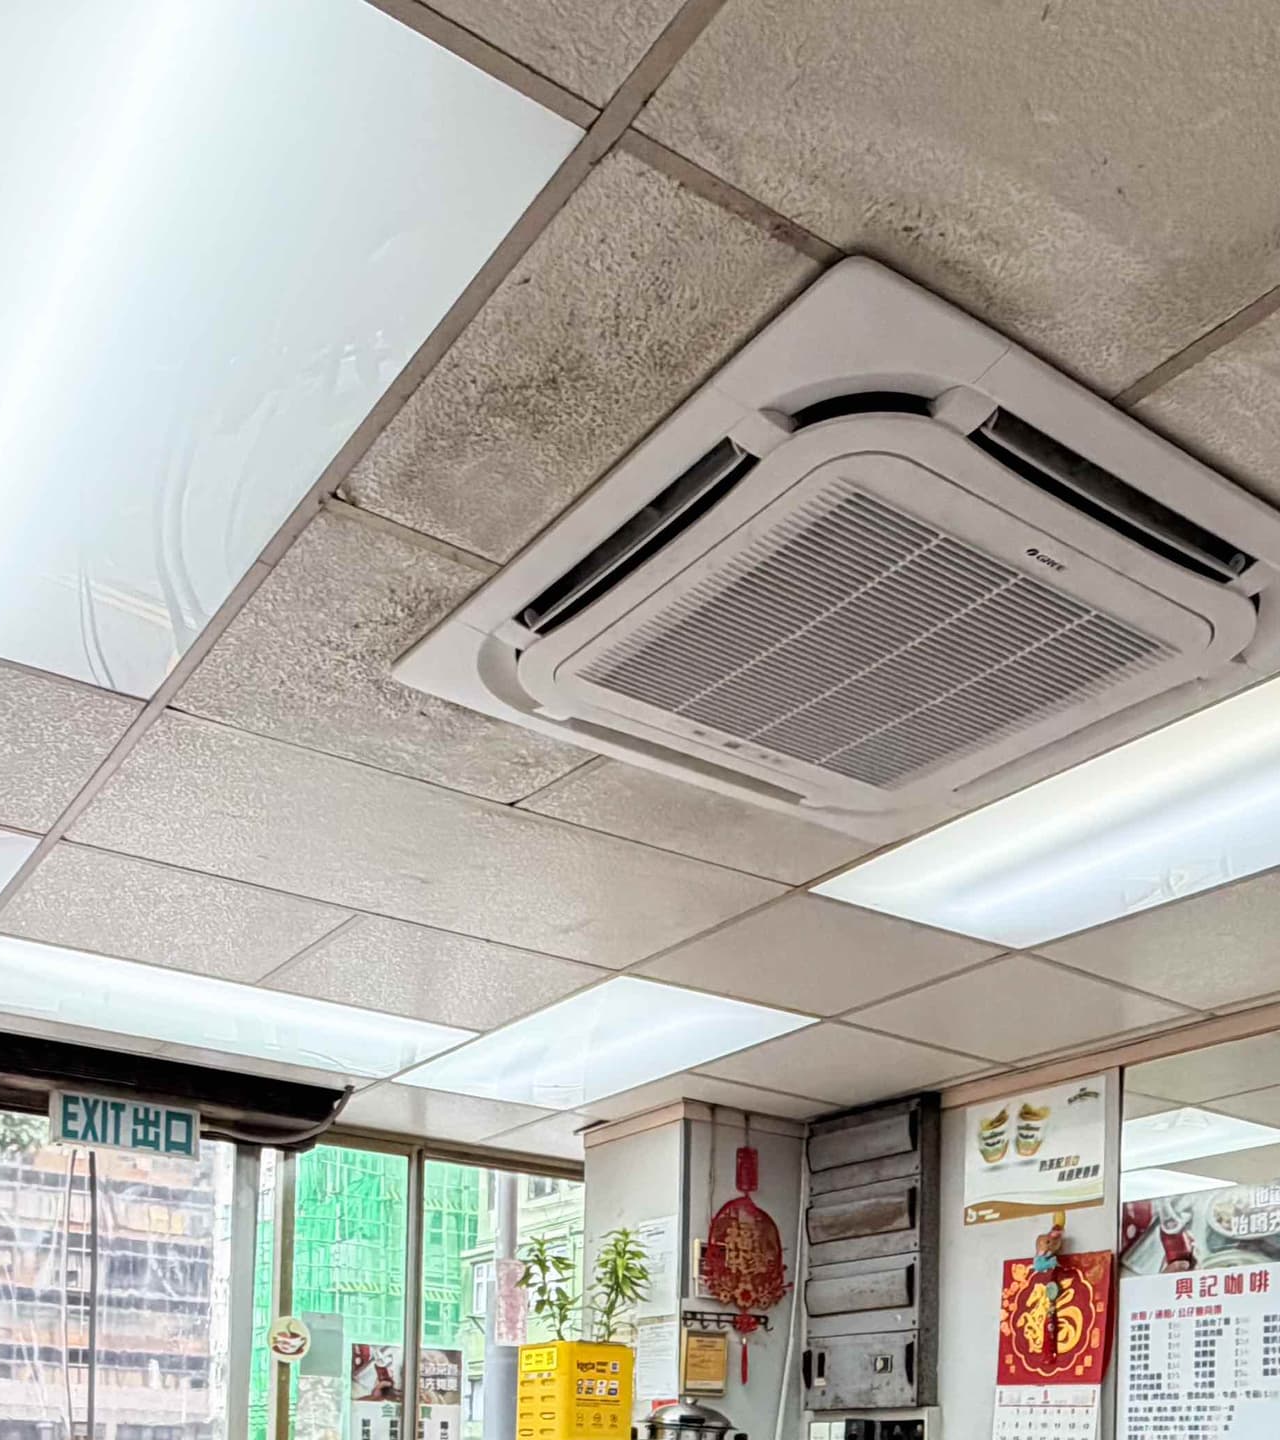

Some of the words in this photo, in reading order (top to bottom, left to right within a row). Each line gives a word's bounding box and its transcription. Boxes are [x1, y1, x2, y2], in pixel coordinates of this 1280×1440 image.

[62, 1094, 126, 1145] EXIT
[132, 1106, 193, 1156] 出口
[1176, 1270, 1270, 1300] 興記咖啡
